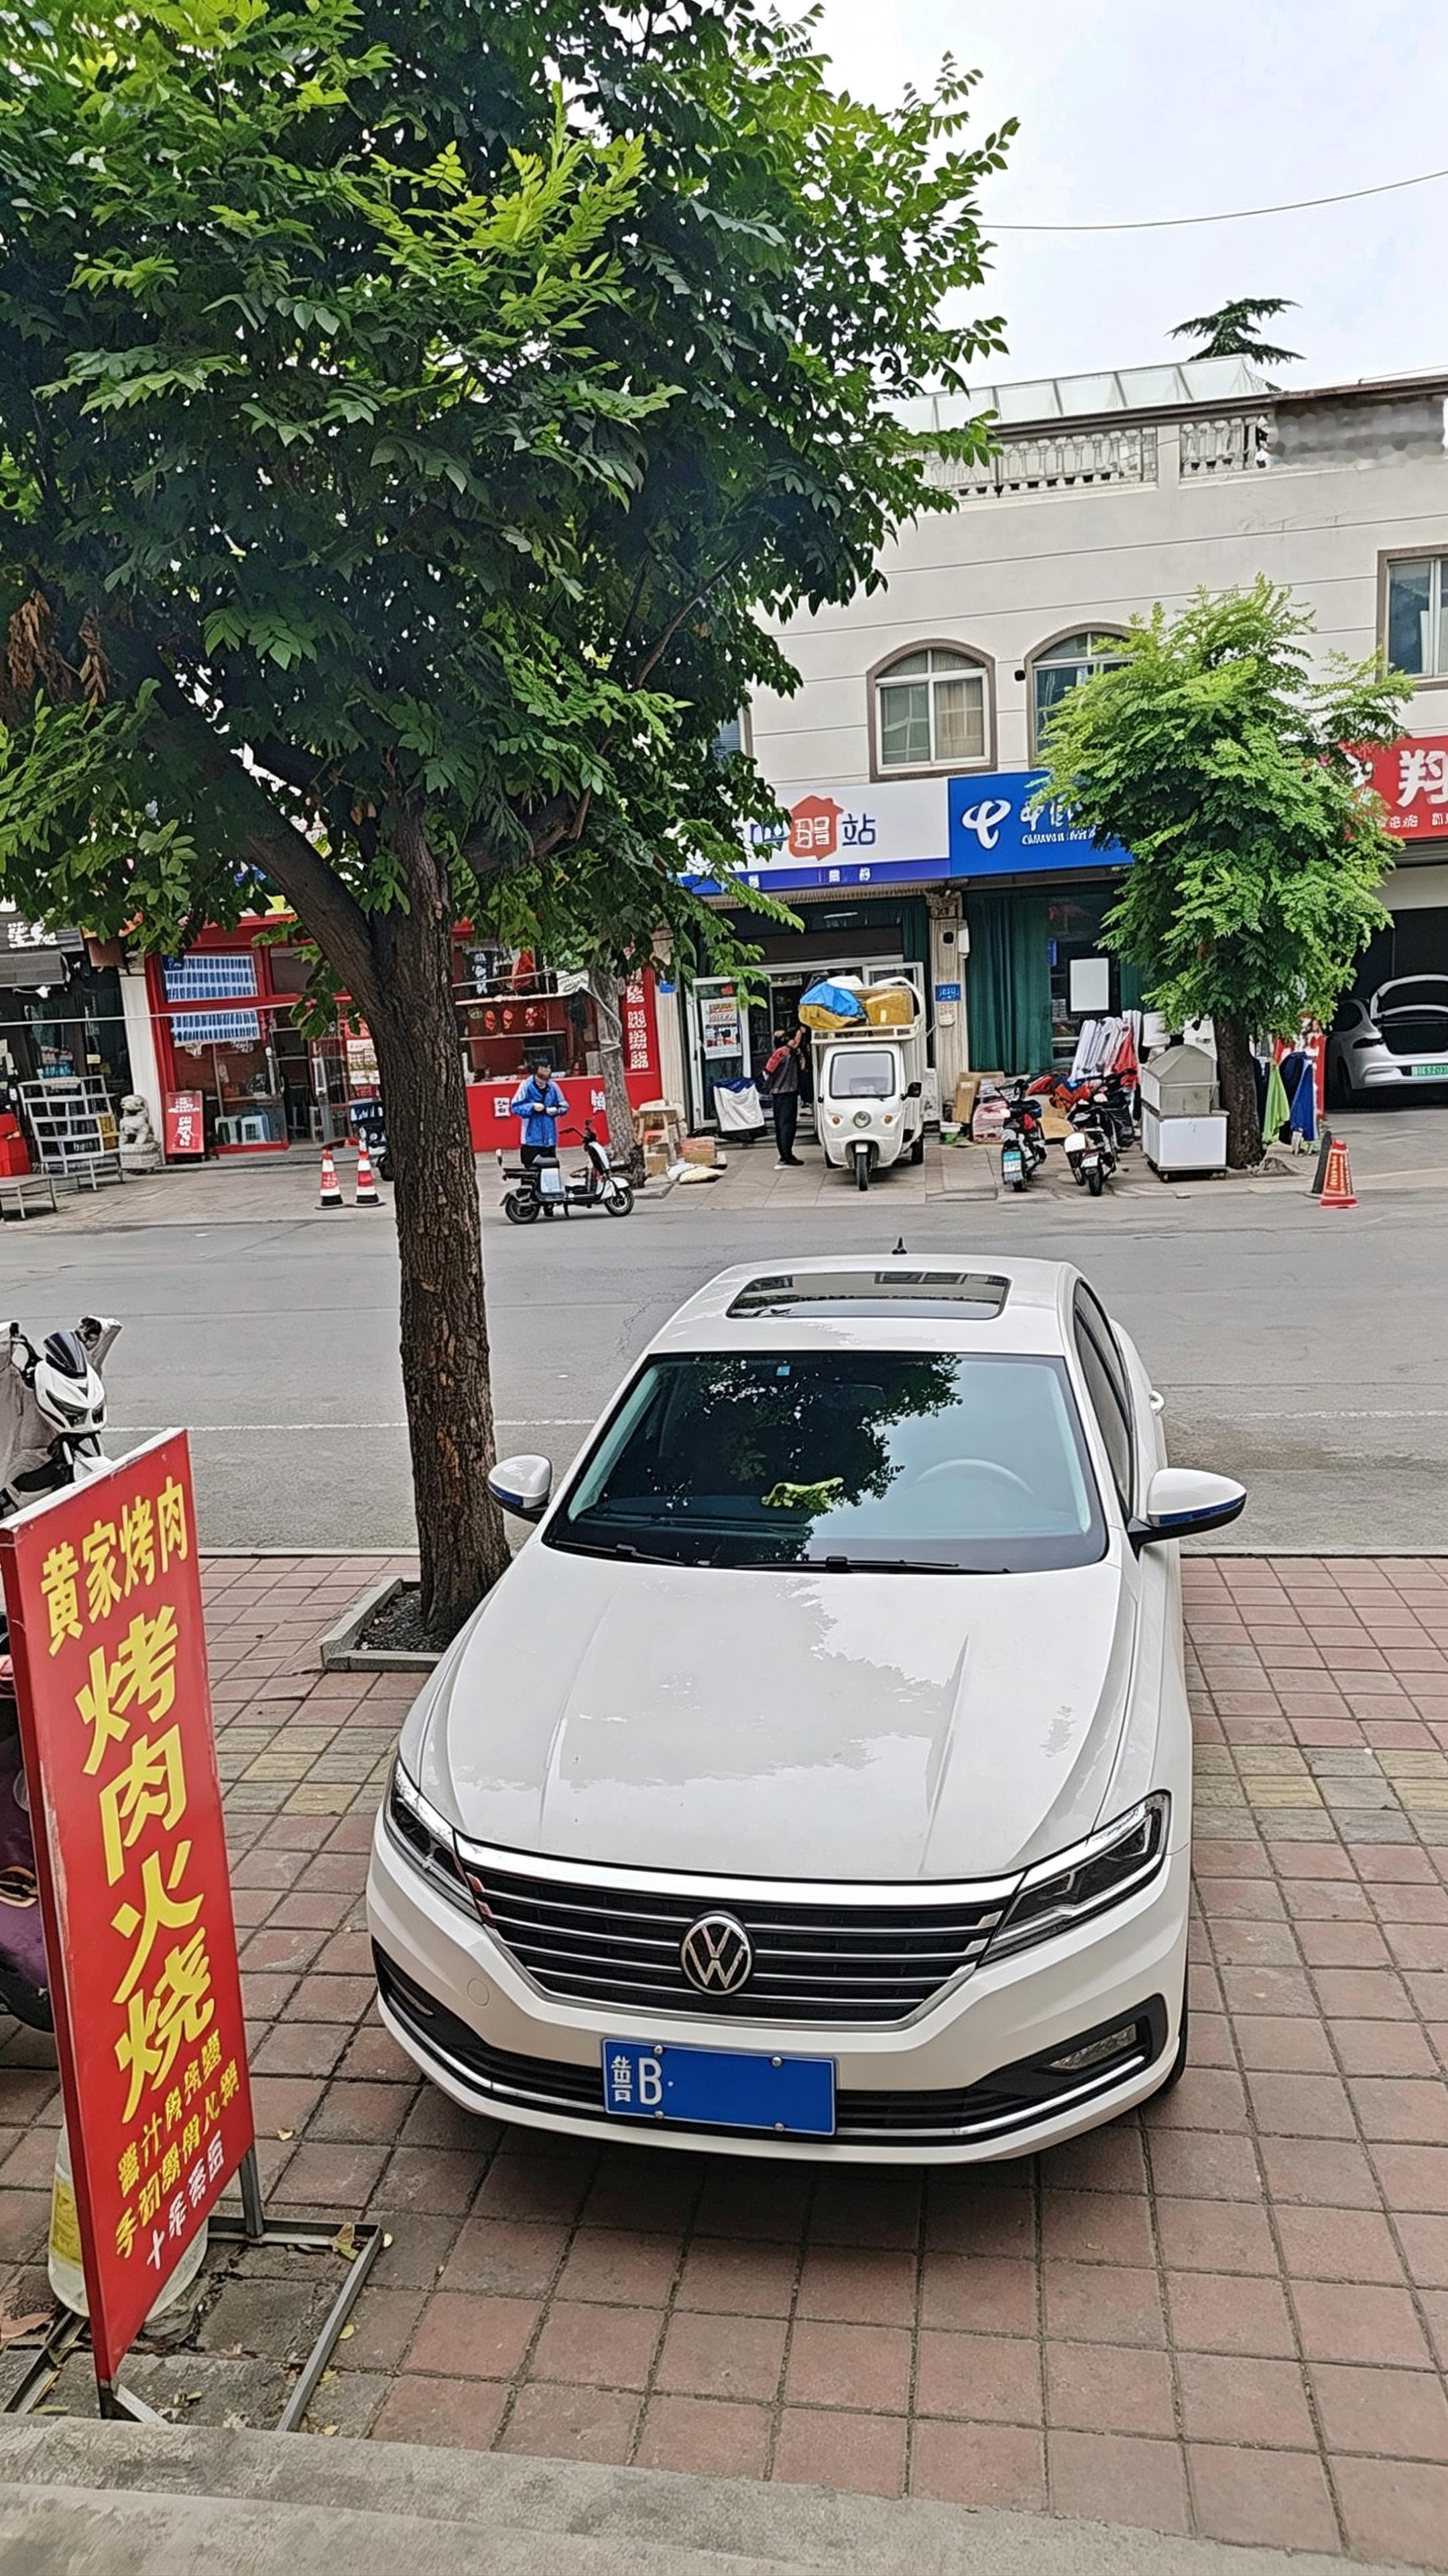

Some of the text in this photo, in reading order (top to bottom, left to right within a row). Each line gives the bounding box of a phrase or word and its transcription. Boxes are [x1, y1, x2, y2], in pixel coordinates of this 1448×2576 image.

[40, 1476, 188, 1657] 黄家烤肉
[74, 1604, 215, 2125] 烤肉火烧
